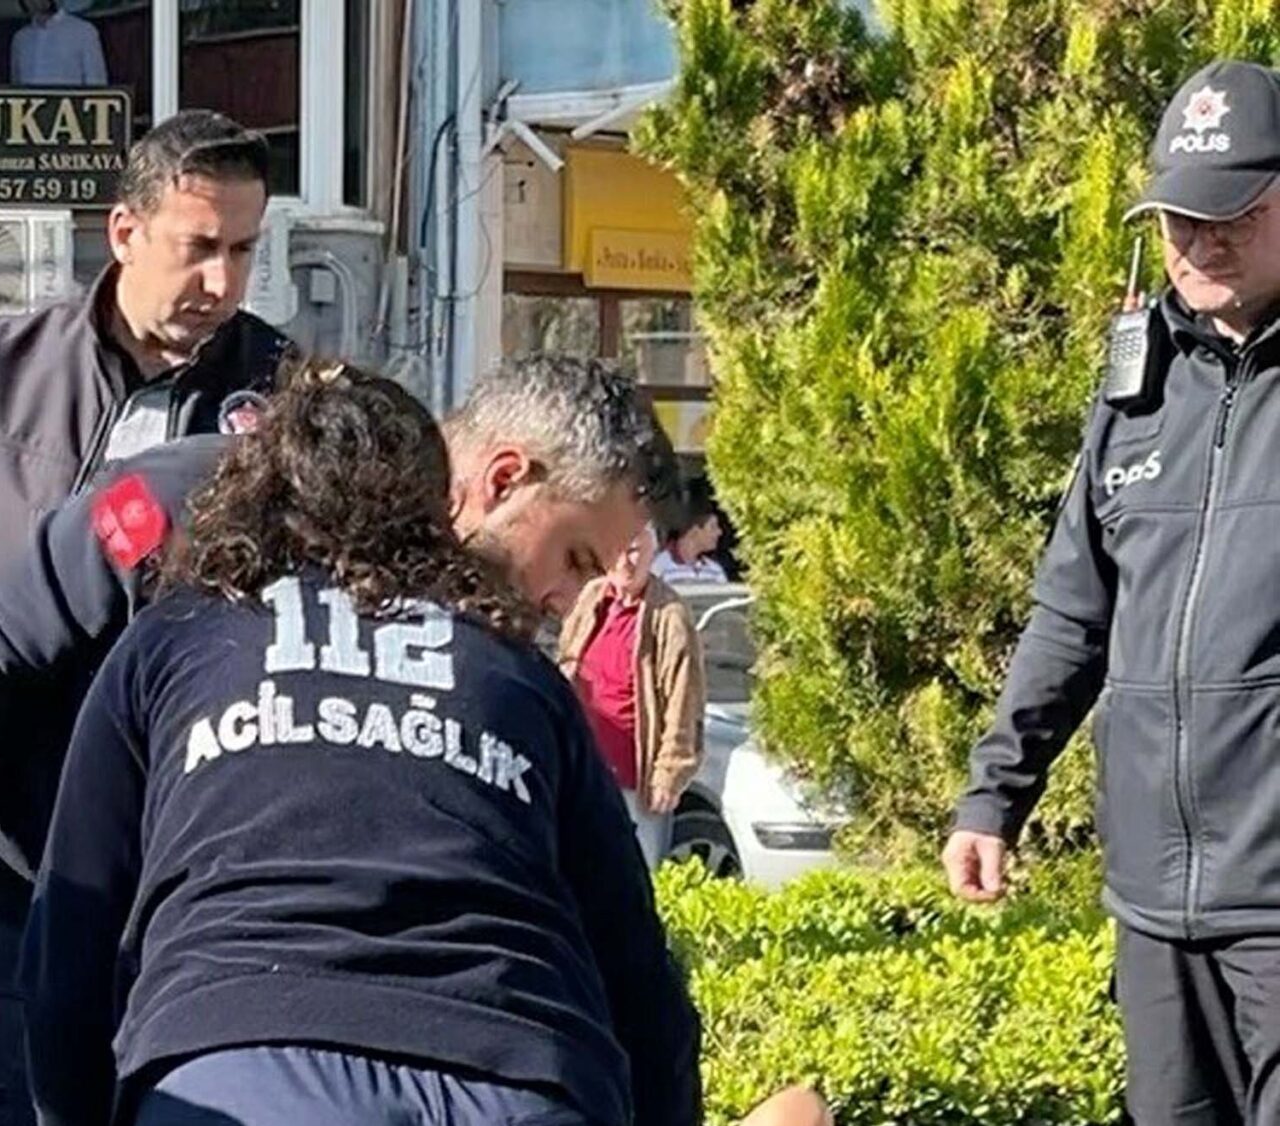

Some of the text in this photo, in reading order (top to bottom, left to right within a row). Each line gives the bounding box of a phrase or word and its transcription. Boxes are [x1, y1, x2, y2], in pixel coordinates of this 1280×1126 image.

[32, 178, 61, 199] 59
[70, 178, 96, 199] 19
[262, 577, 455, 689] 112
[184, 680, 531, 803] ACİL SAĞLIK
